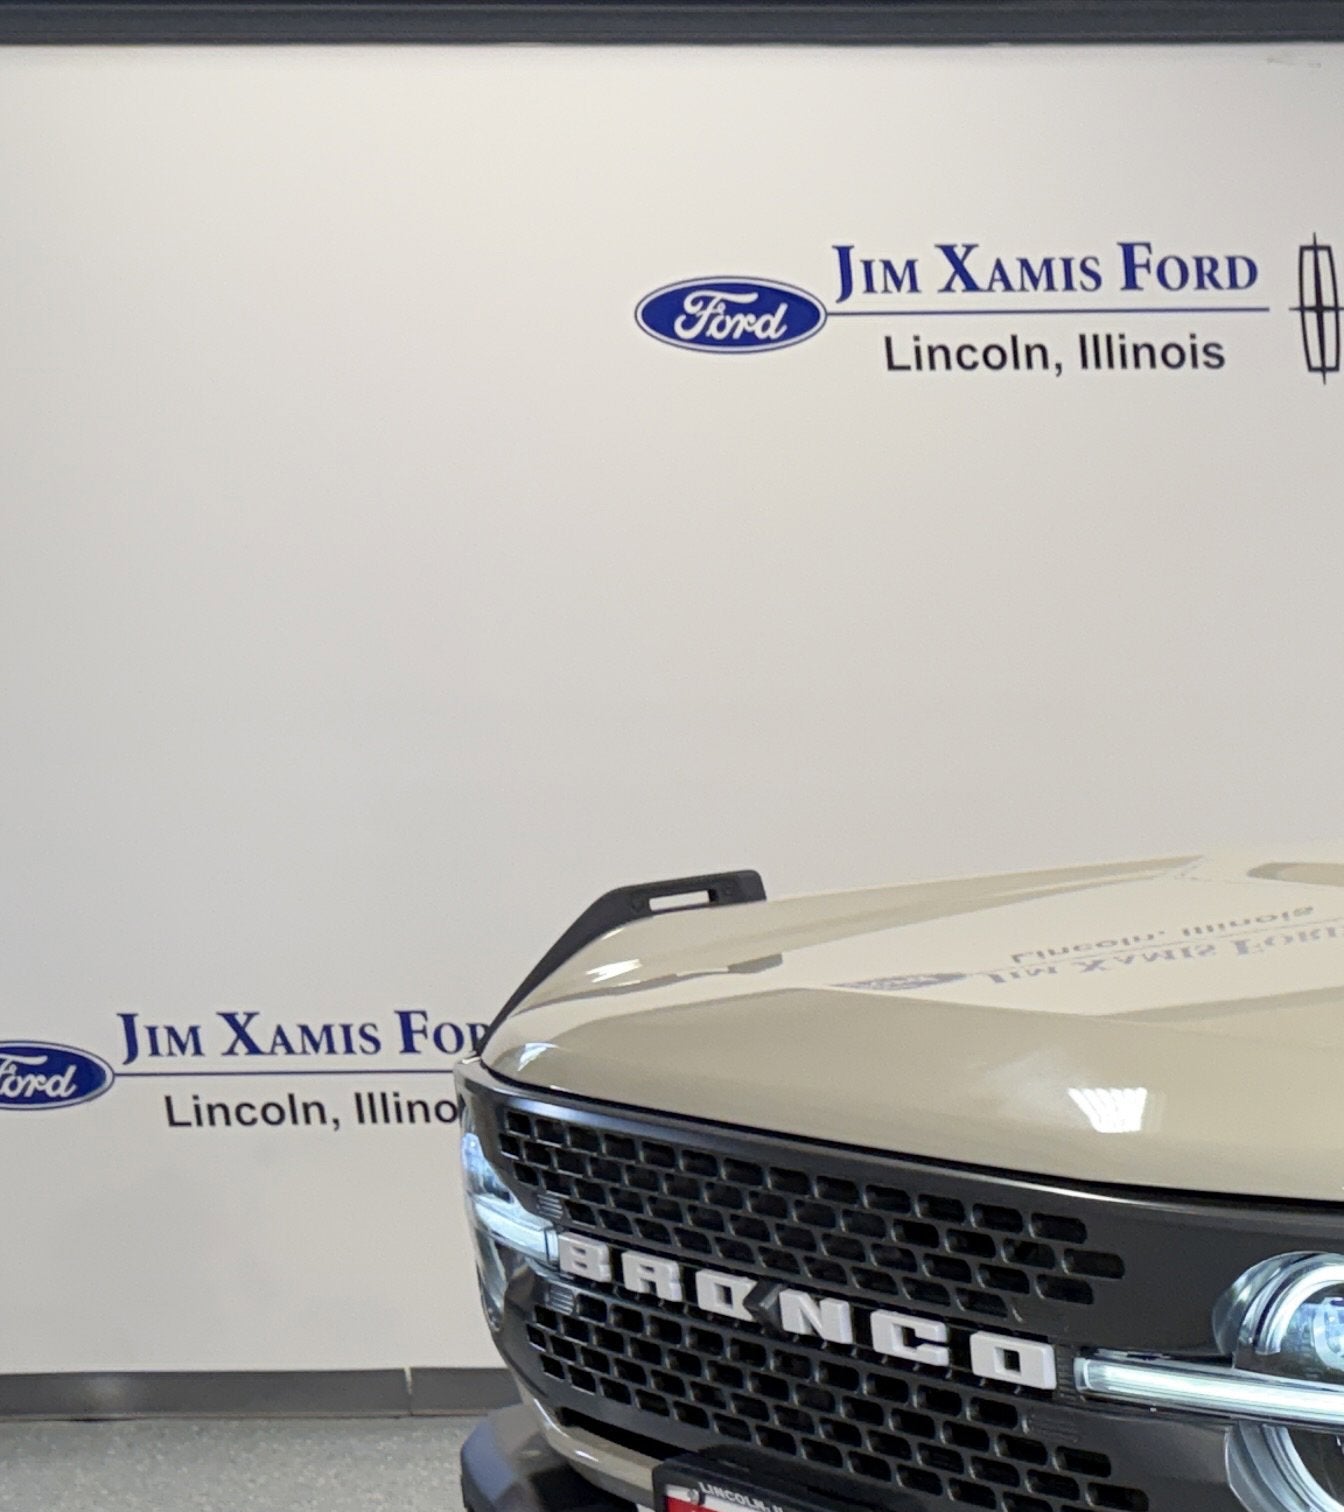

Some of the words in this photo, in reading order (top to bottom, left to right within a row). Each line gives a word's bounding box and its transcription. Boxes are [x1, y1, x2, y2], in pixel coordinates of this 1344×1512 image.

[831, 244, 920, 303] JIM
[933, 242, 1102, 294] XAMIS
[1116, 241, 1259, 293] FORD
[673, 288, 788, 341] Ford
[884, 333, 1064, 378] Lincoln,
[1078, 332, 1226, 371] Illinois
[116, 1012, 204, 1066] JIM
[216, 1011, 382, 1057] XAMIS
[164, 1093, 341, 1131] Lincoln,
[355, 1091, 458, 1125] Illino
[558, 1231, 1058, 1391] BRONCO
